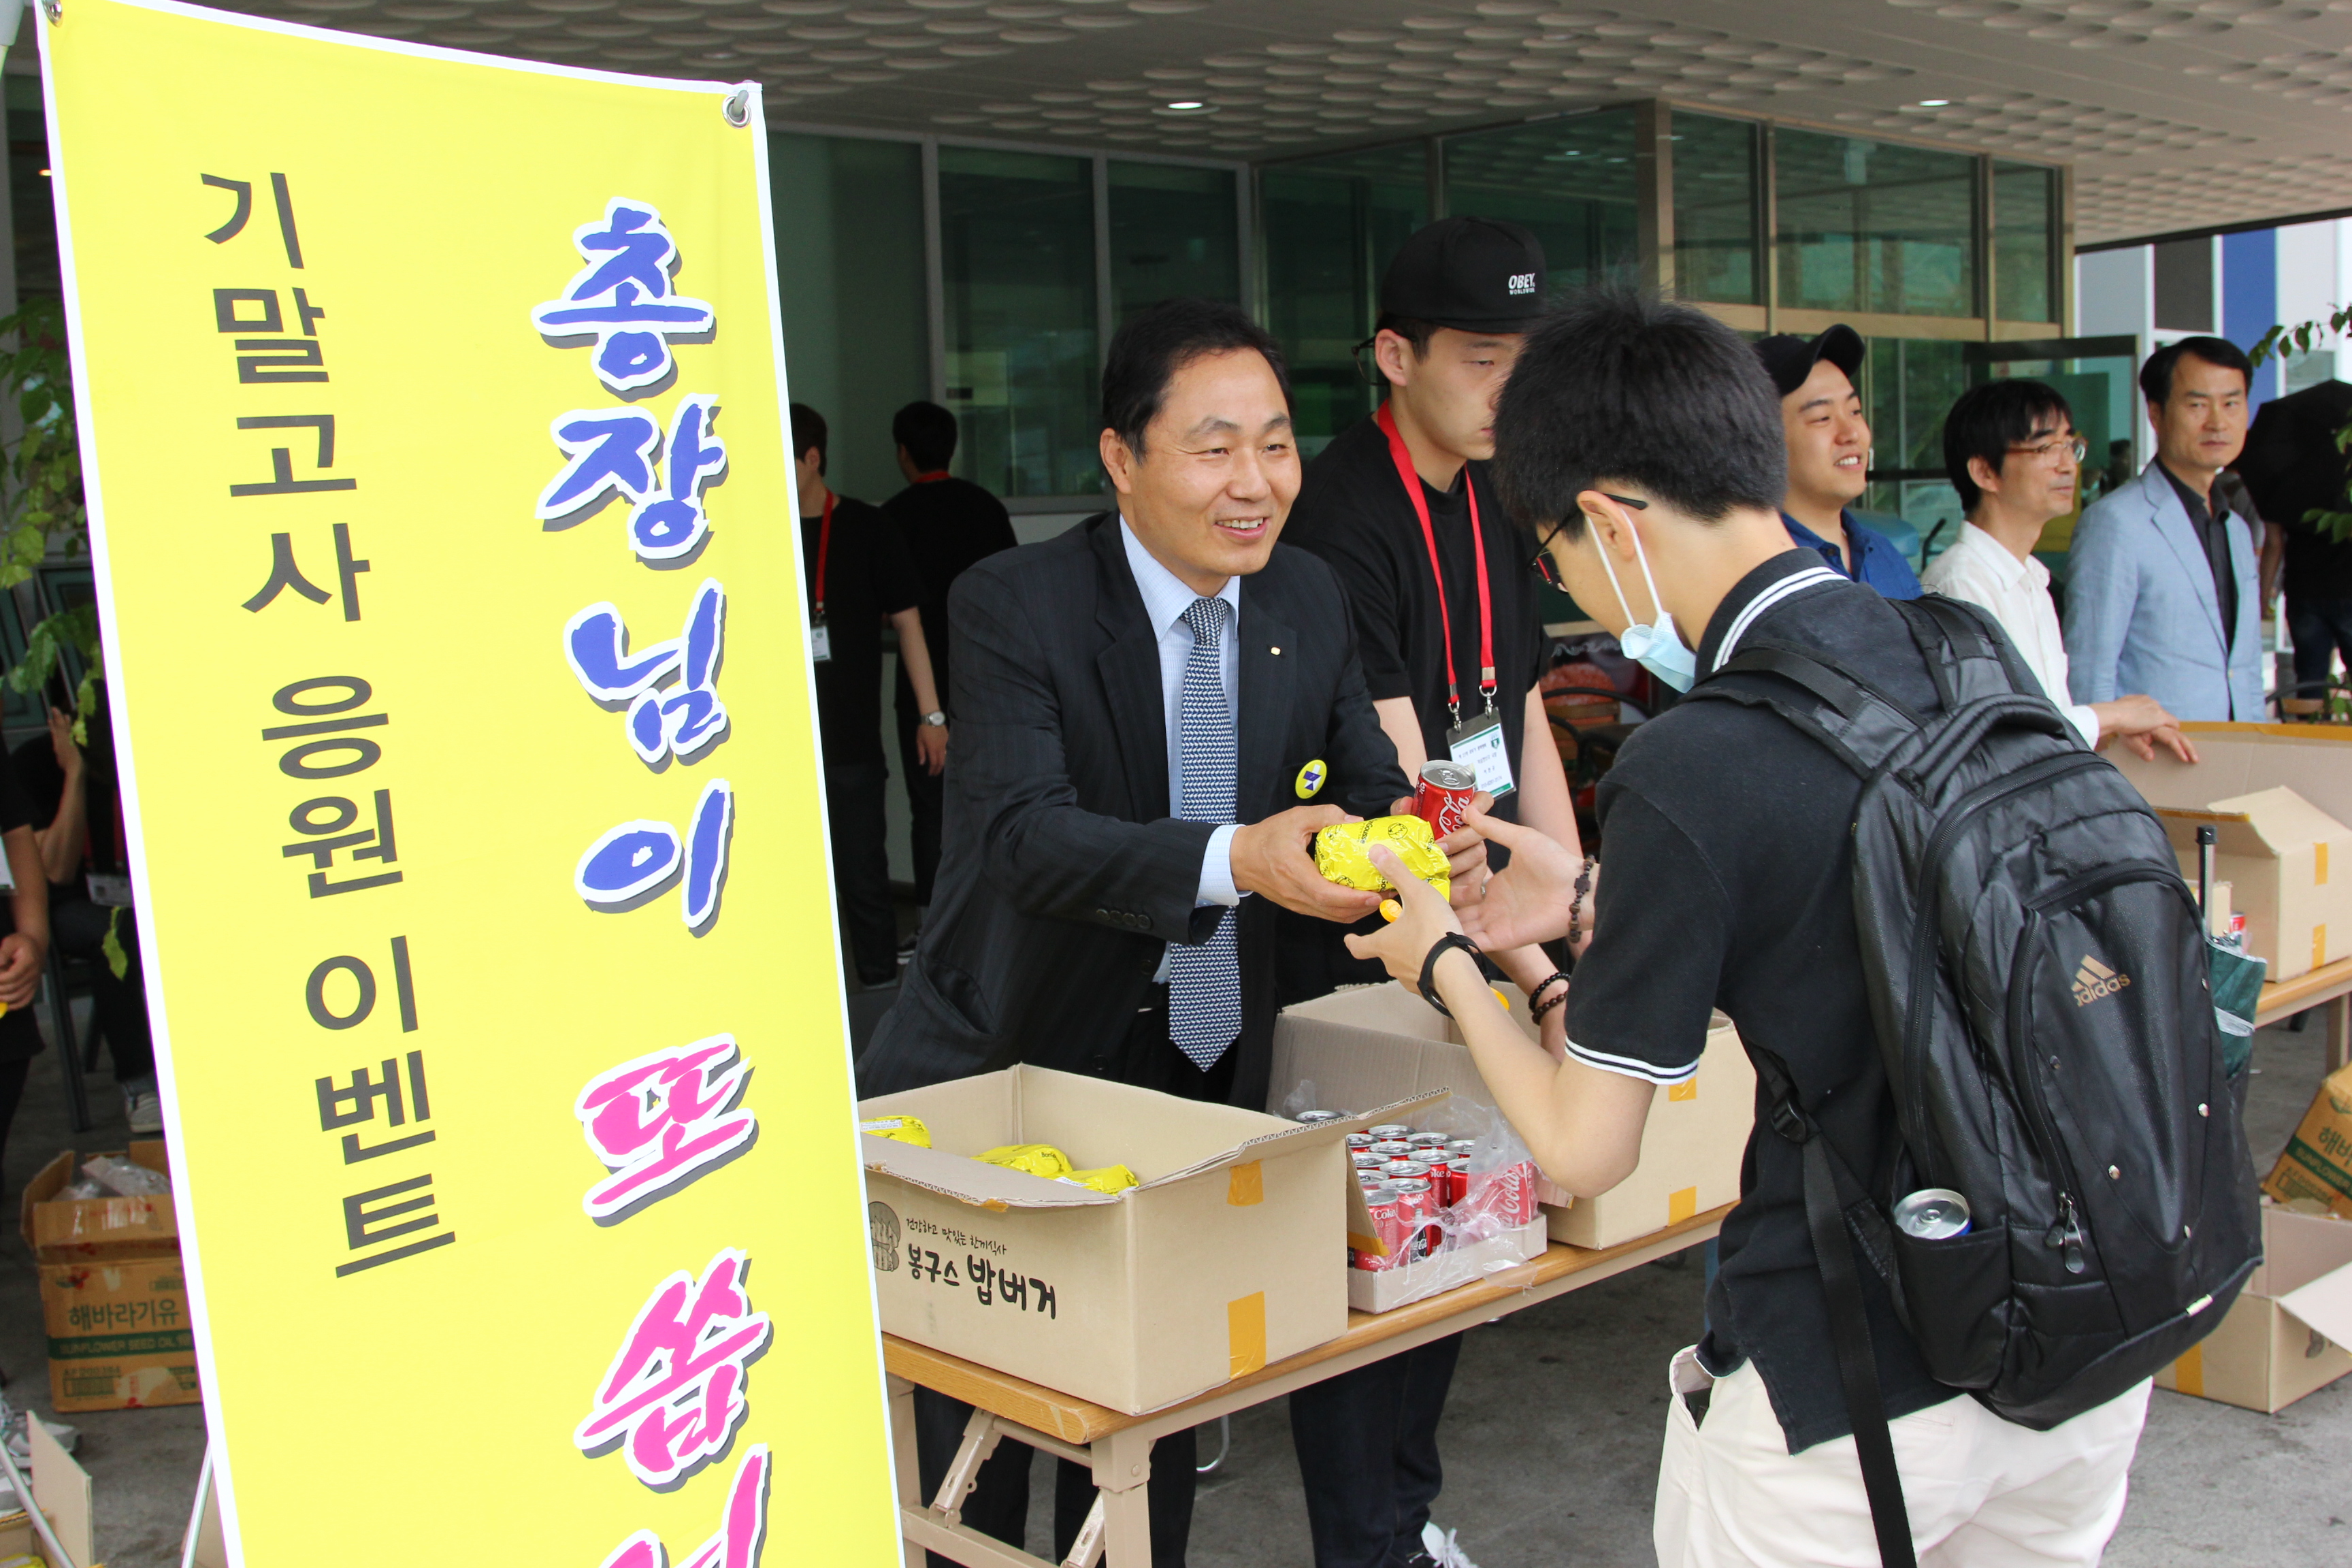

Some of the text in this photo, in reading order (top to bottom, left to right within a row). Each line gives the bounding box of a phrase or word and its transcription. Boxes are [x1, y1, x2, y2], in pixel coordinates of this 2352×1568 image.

[1508, 273, 1535, 289] OBEY
[1509, 287, 1535, 295] WORLDWIDE
[533, 197, 732, 927] 총장님이
[201, 172, 455, 1280] 기말고사 응원 이벤트
[574, 1032, 755, 1218] 또
[1374, 1209, 1396, 1220] Coke
[906, 1218, 938, 1235] 건강하고
[942, 1228, 967, 1246] 맛있는
[908, 1243, 1056, 1320] 봉구스 밥버거
[68, 1298, 179, 1330] 해바라기유
[60, 1341, 125, 1354] SUNFLOWER
[129, 1338, 156, 1350] SEED
